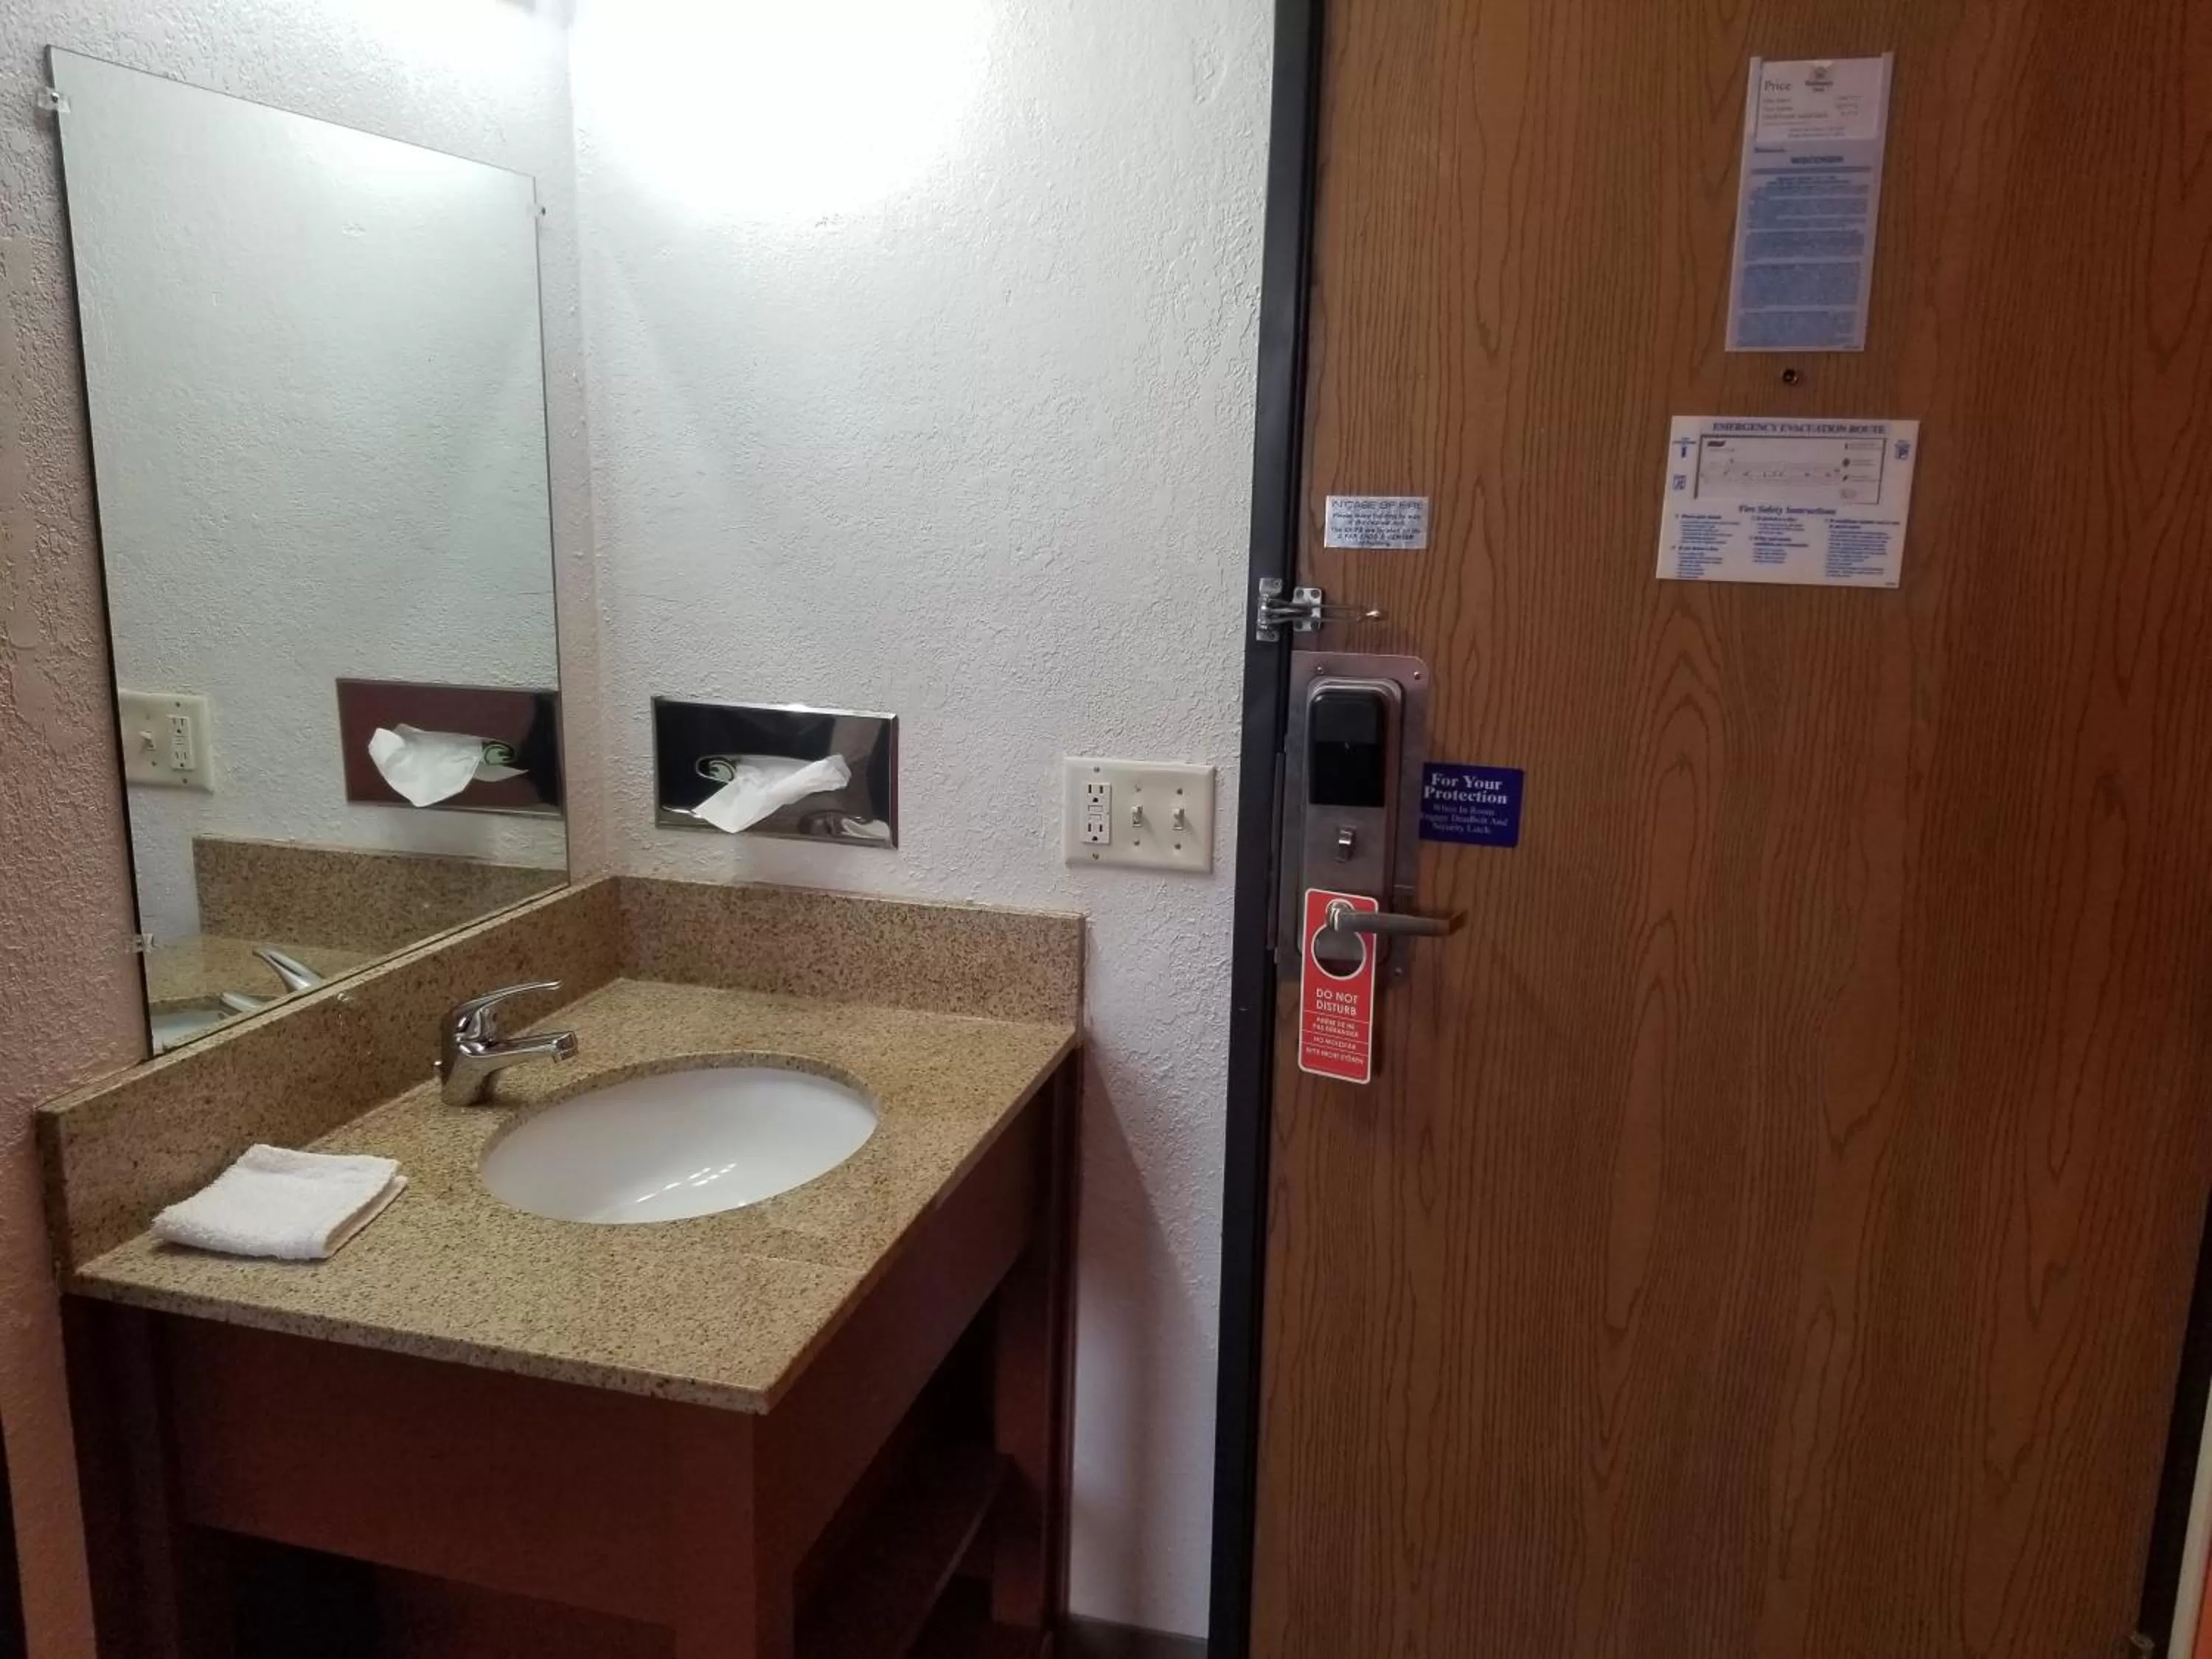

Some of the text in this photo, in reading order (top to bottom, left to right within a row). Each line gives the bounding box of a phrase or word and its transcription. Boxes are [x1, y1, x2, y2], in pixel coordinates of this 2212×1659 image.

[1764, 80, 1792, 92] Price
[1713, 422, 1886, 434] EMERGENCY EVACUATION ROUTE
[1431, 773, 1503, 790] For Your
[1424, 785, 1508, 804] Protection
[1316, 988, 1358, 1004] DO NOT
[1316, 1000, 1357, 1015] DISTURB
